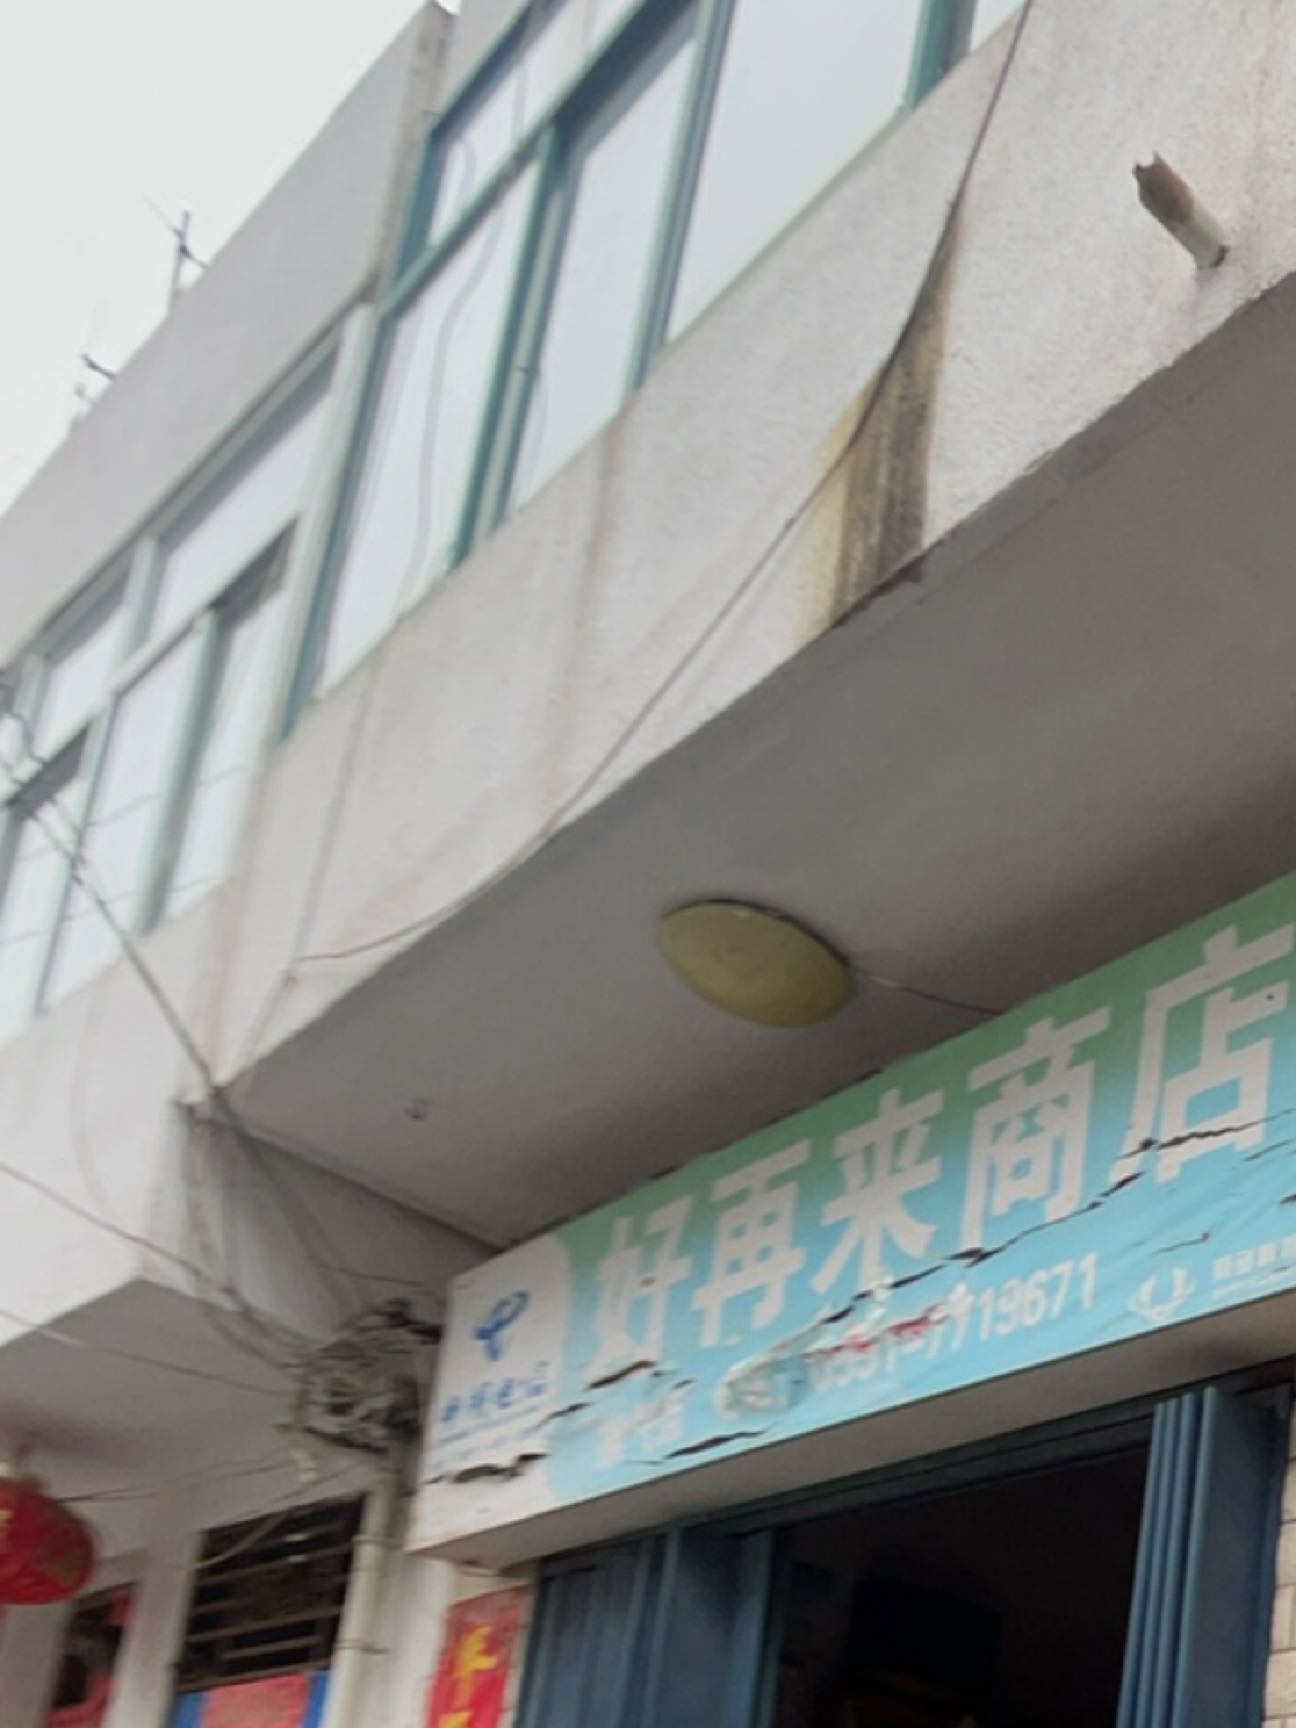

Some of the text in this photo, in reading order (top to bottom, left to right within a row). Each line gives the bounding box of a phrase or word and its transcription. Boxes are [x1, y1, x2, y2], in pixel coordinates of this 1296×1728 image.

[585, 923, 1296, 1373] 好再来商店
